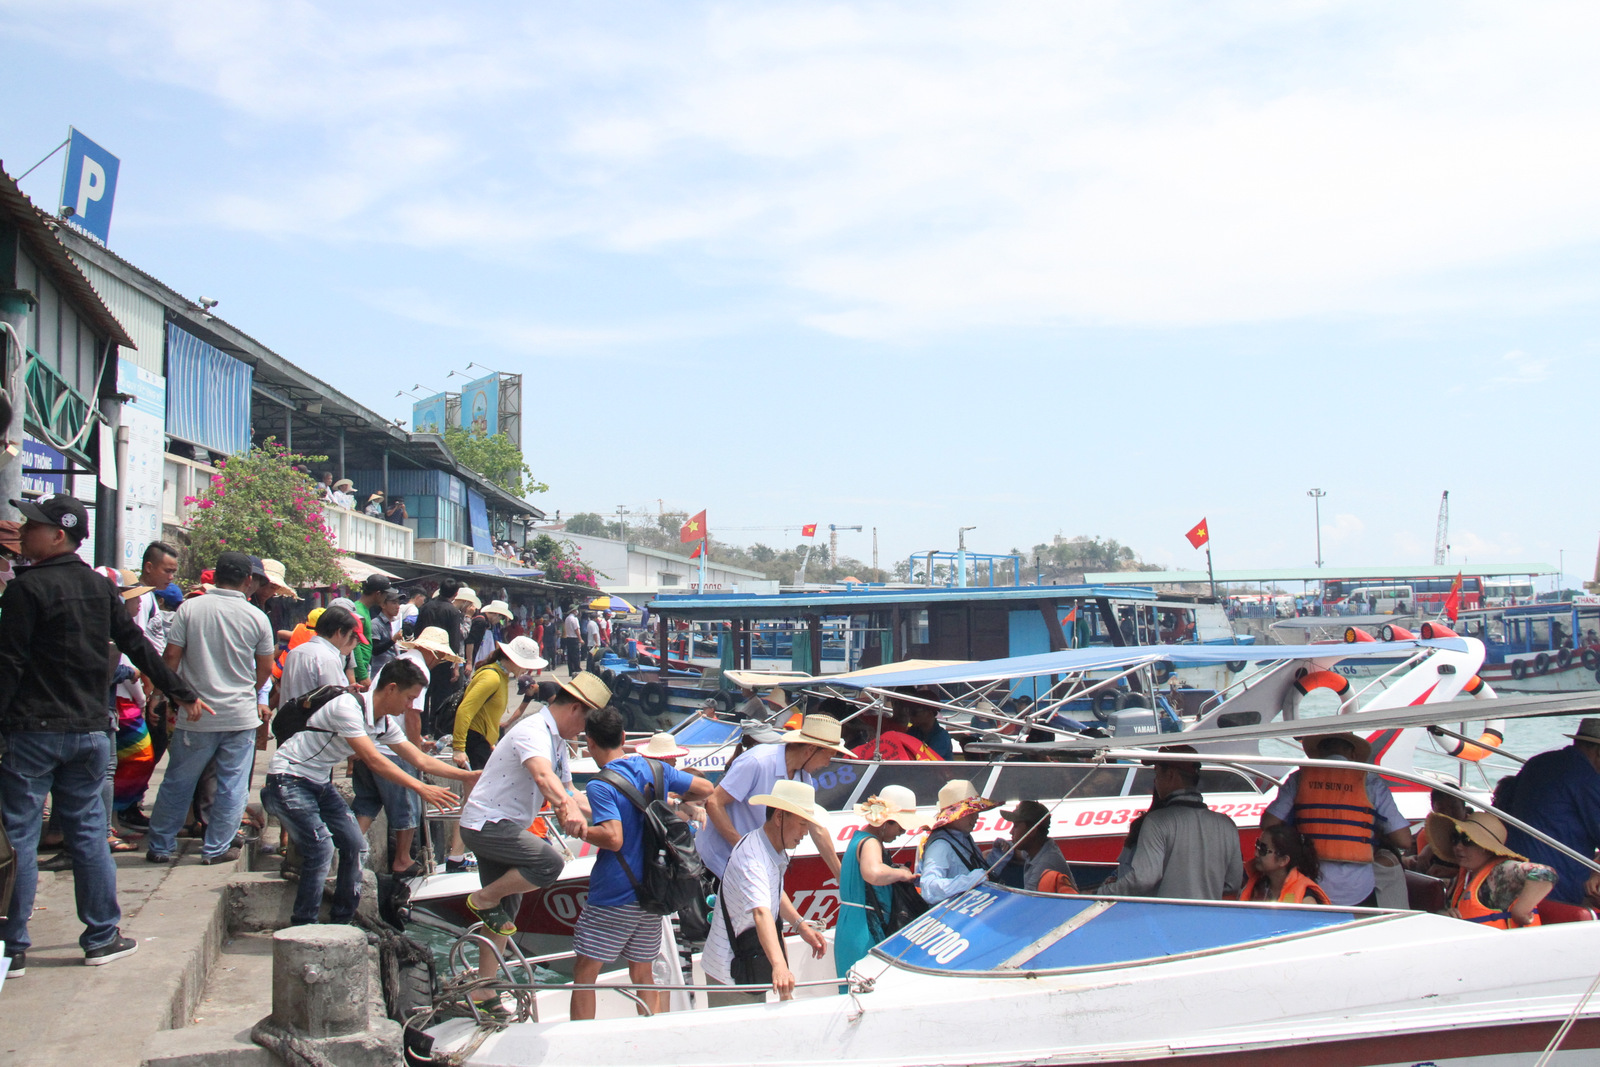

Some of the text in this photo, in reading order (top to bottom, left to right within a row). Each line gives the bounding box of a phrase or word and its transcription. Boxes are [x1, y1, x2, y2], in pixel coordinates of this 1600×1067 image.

[76, 154, 105, 219] P
[1308, 781, 1323, 789] VIN
[1325, 782, 1341, 791] SUN
